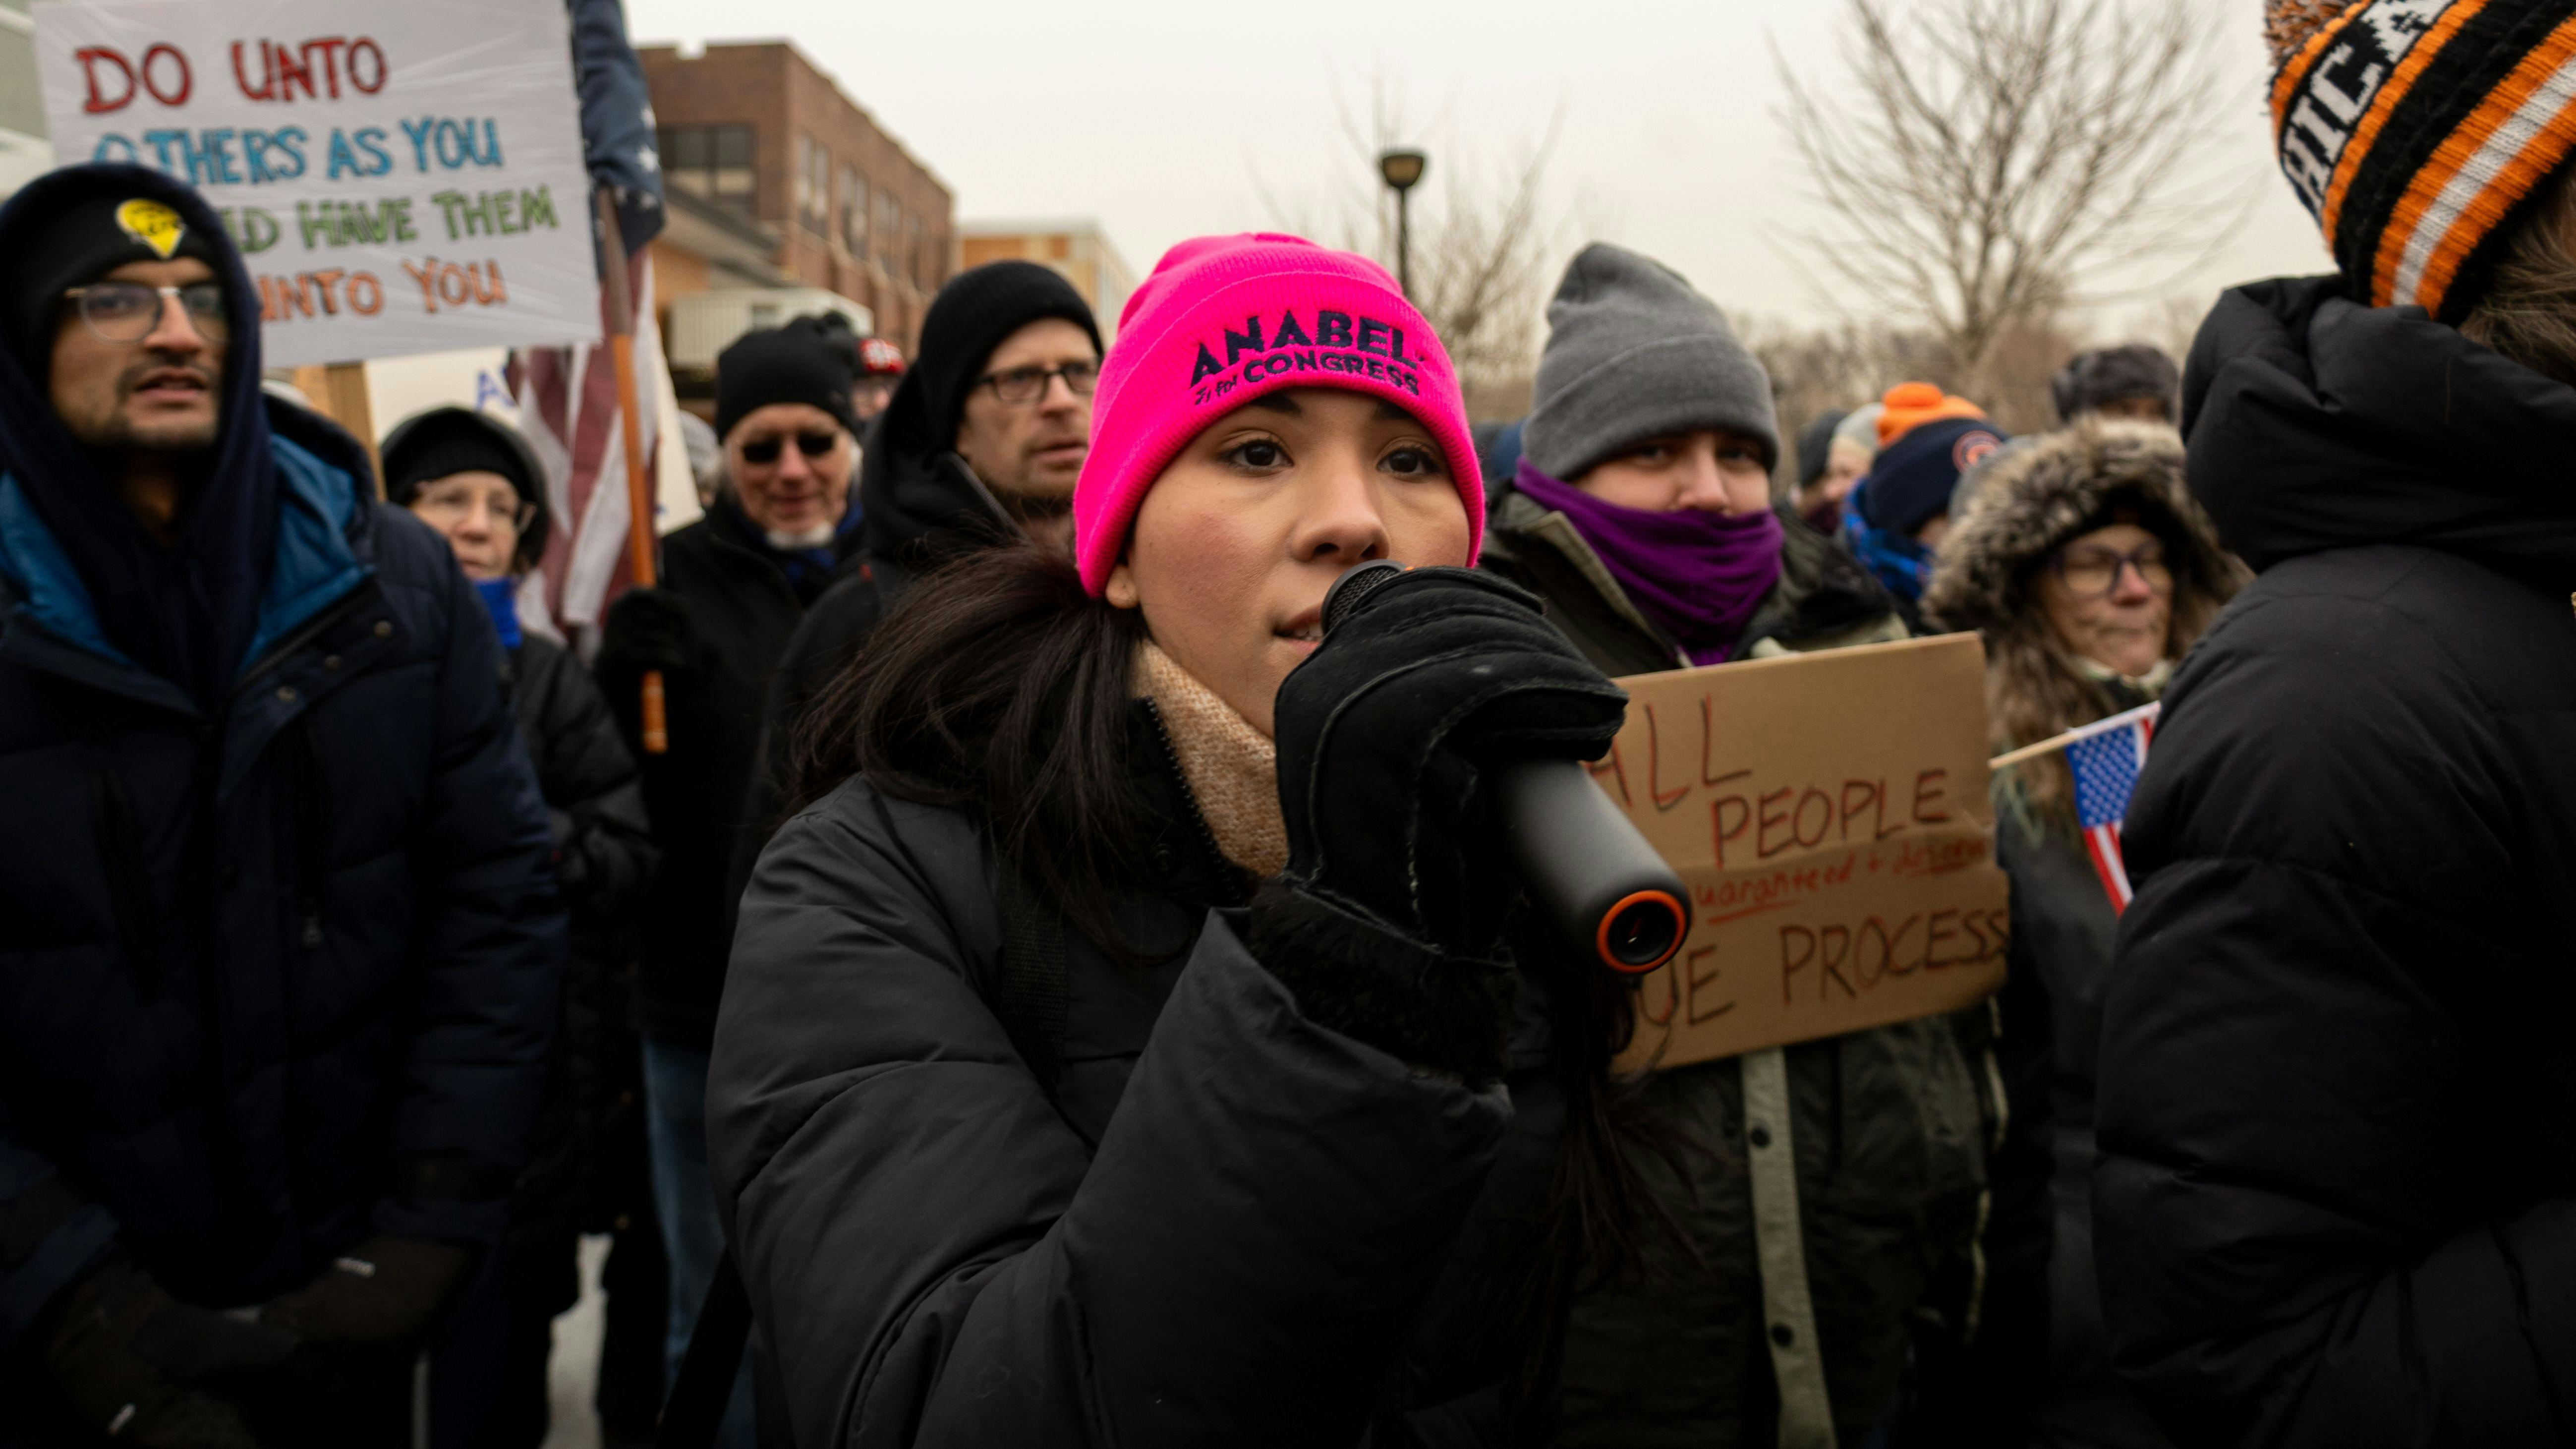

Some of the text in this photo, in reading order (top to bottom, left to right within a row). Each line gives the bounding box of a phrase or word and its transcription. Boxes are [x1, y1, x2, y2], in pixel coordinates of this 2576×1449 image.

[75, 37, 388, 113] DO UNTO
[2280, 0, 2453, 216] HICA
[327, 127, 393, 180] AS
[400, 116, 503, 172] YOU
[296, 197, 417, 249] HAVE
[432, 184, 559, 241] THEM
[401, 257, 507, 313] YOU
[1190, 310, 1417, 387] ANABEL
[1244, 350, 1419, 396] CONGRESS
[1712, 769, 1948, 869] PEOPLE
[1694, 852, 1856, 908] uaranteed
[1637, 908, 2011, 1025] UE PROCESS
